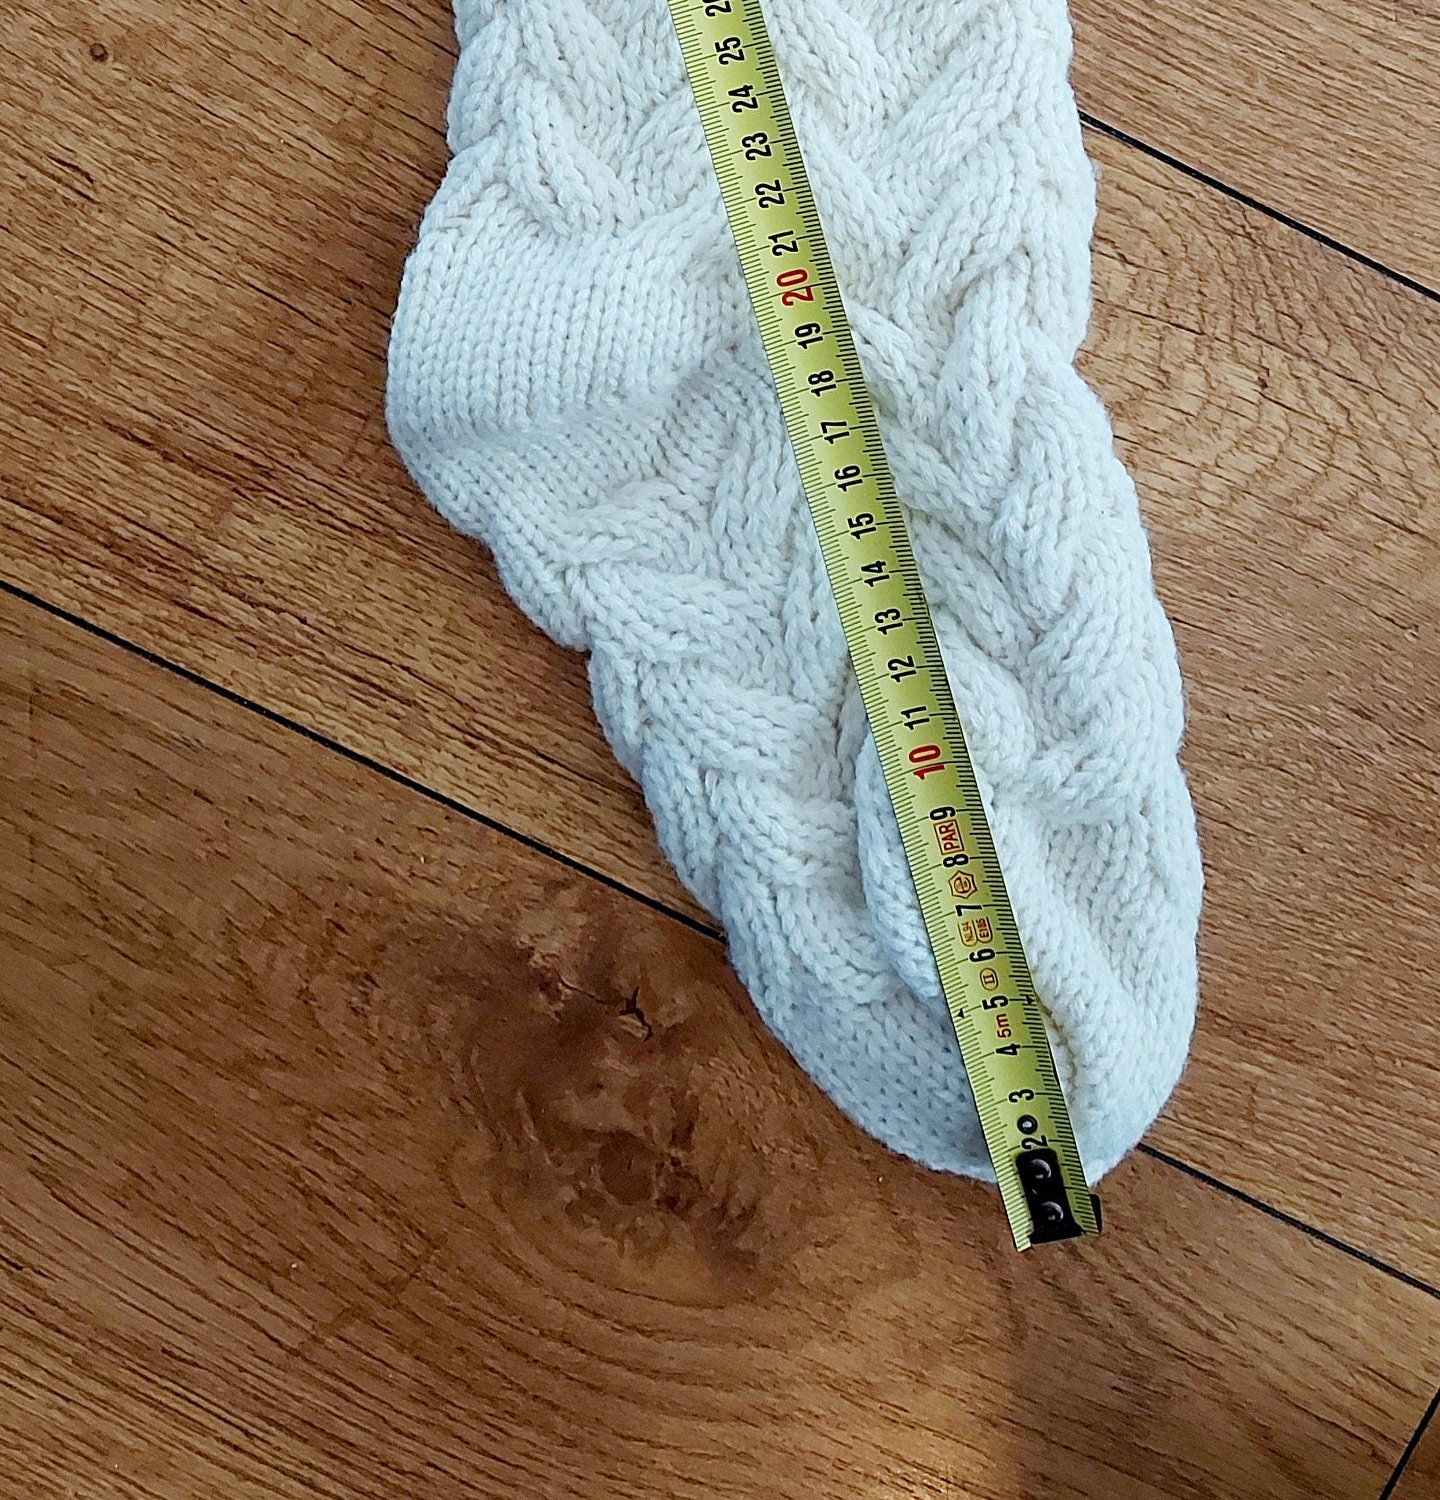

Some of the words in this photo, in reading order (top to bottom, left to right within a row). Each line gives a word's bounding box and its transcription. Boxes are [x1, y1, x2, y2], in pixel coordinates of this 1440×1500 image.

[714, 36, 746, 66] 25
[727, 84, 759, 113] 24
[741, 132, 772, 161] 23
[754, 179, 786, 209] 22
[768, 229, 799, 257] 21
[776, 269, 814, 307] 20
[794, 322, 825, 350] 19
[807, 369, 837, 397] 18
[820, 420, 850, 445] 17
[834, 464, 863, 492] 16
[847, 512, 877, 540] 15
[860, 560, 891, 588] 14
[874, 608, 904, 636] 13
[888, 656, 918, 683] 12
[900, 705, 930, 731] 11
[908, 744, 945, 781] 10
[929, 806, 956, 821] 9
[937, 822, 961, 852] PAR
[942, 853, 969, 868] 8
[955, 904, 983, 917] 7
[969, 949, 996, 963] 6
[981, 995, 1009, 1010] 5
[996, 1013, 1012, 1038] 5m
[995, 1043, 1021, 1057] 4
[1008, 1088, 1035, 1103] 3
[1021, 1134, 1048, 1150] 2
